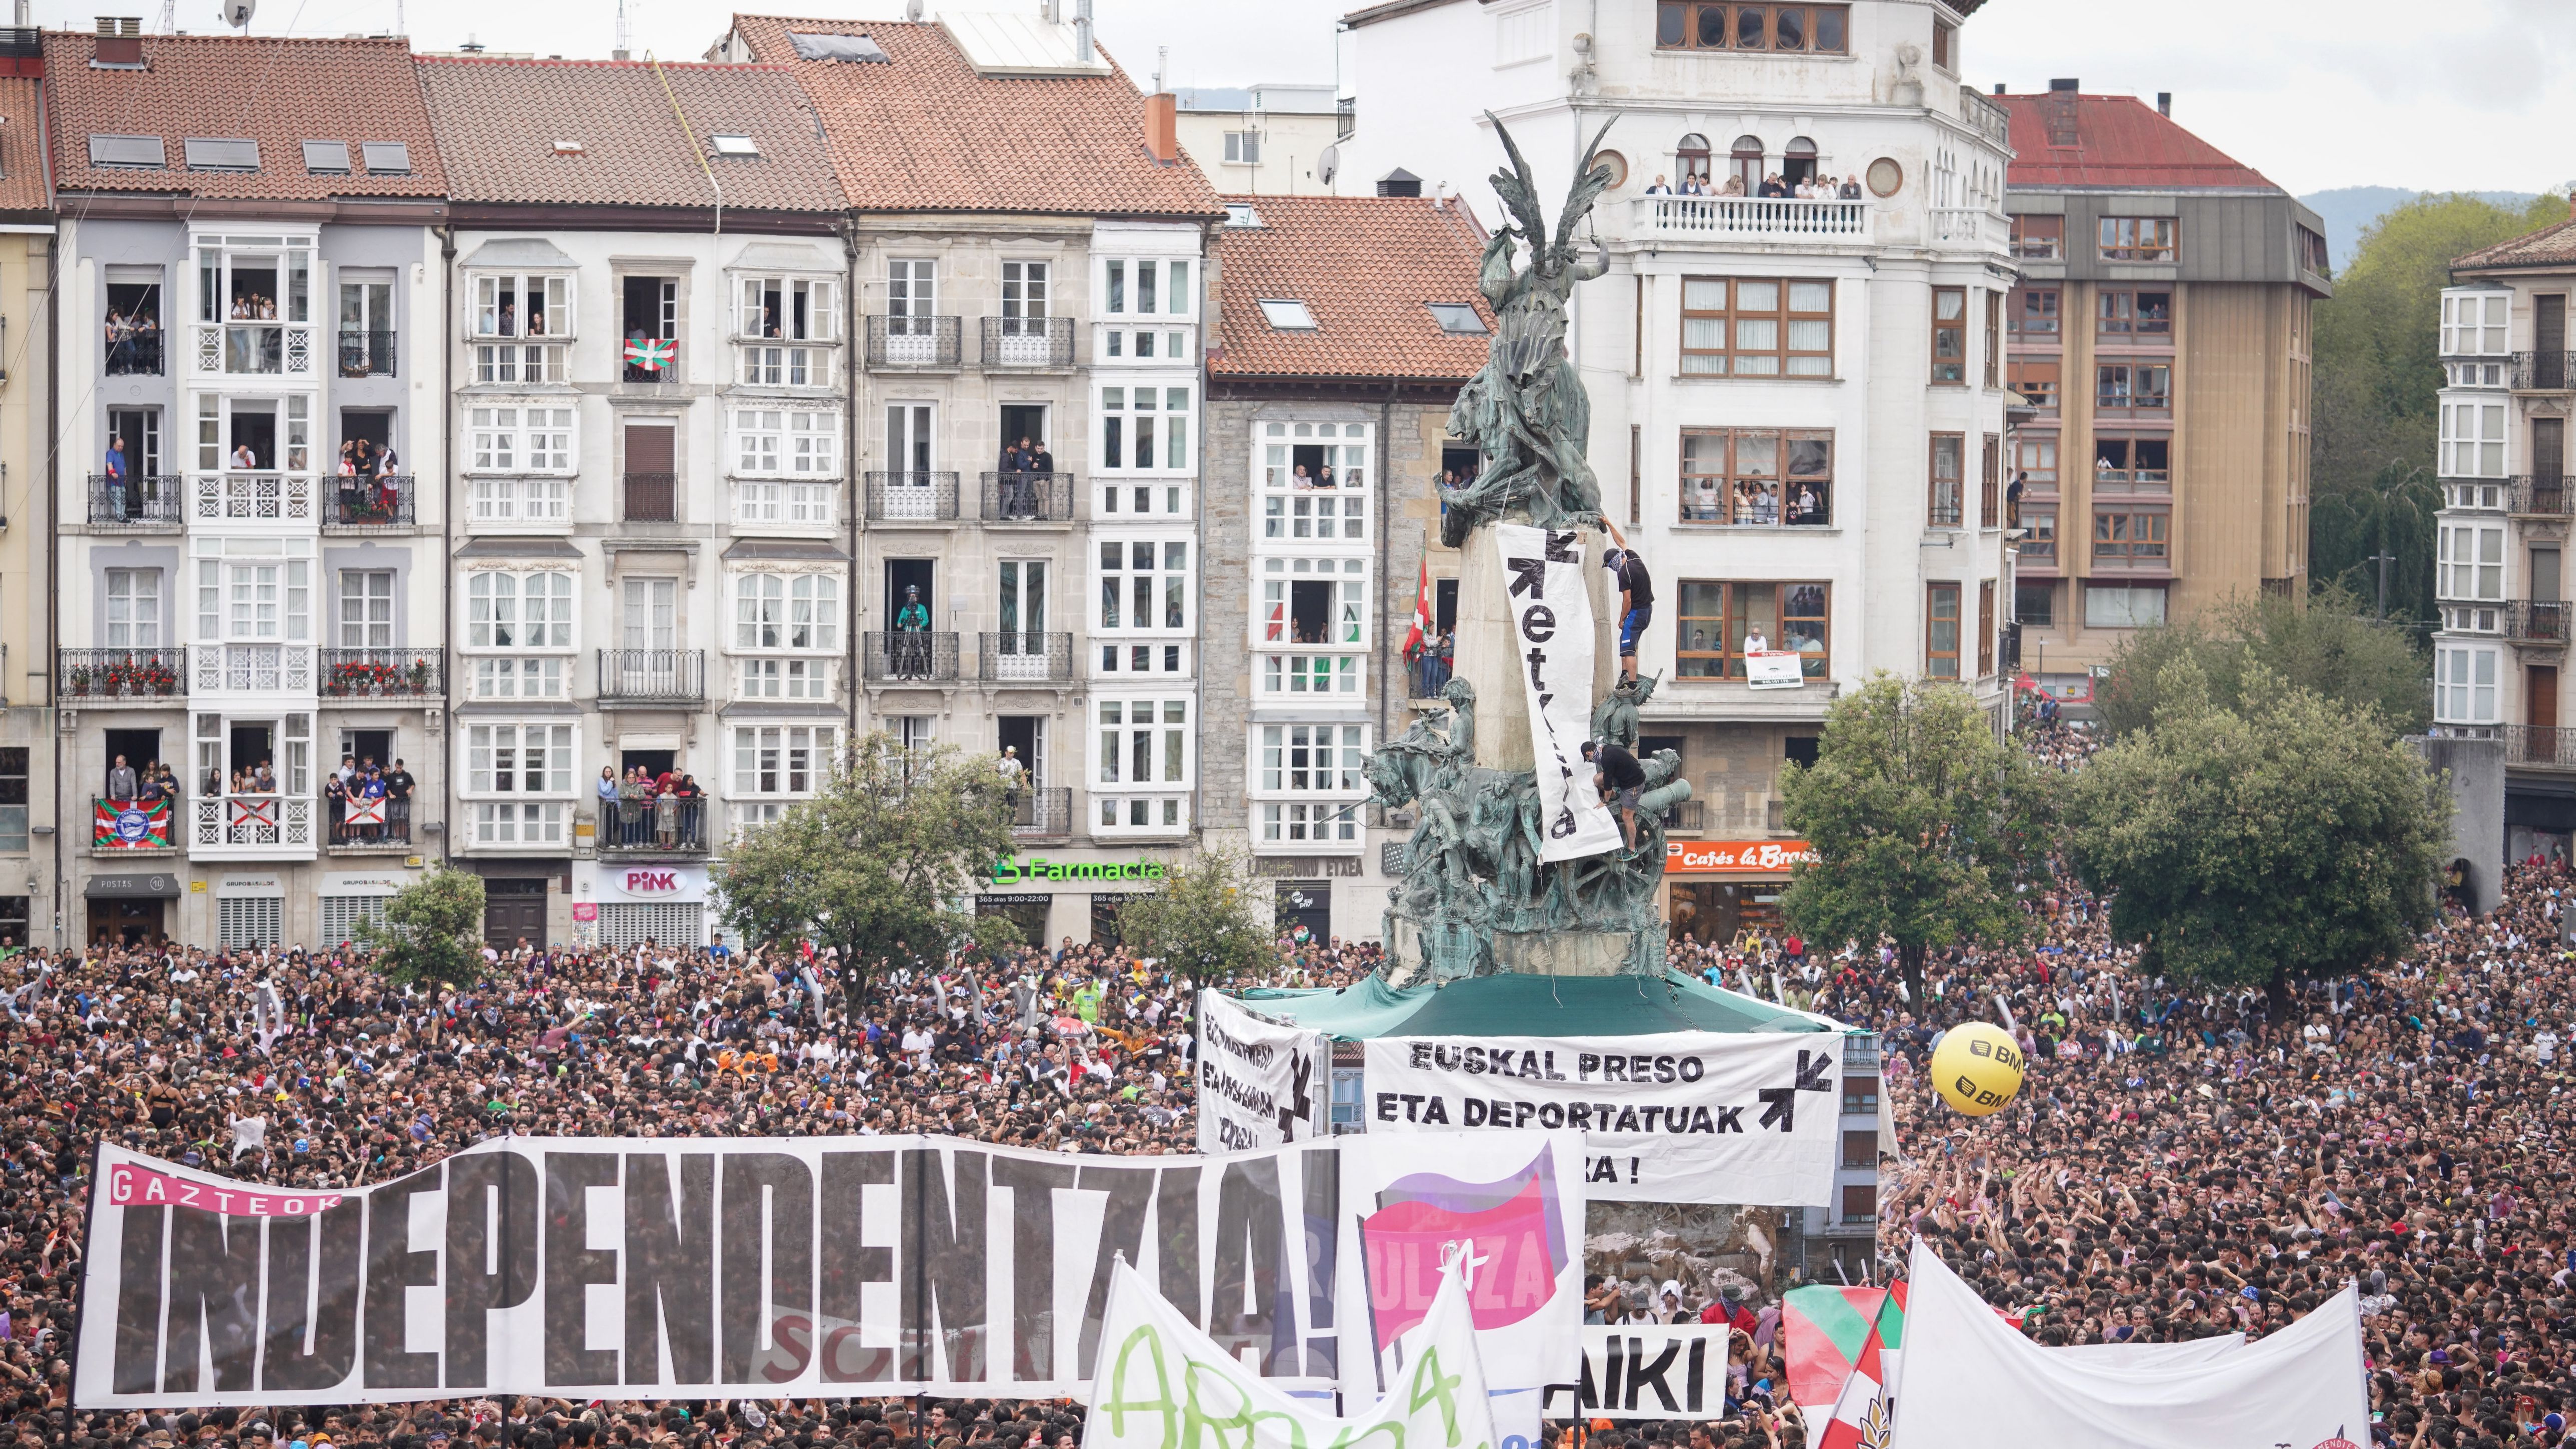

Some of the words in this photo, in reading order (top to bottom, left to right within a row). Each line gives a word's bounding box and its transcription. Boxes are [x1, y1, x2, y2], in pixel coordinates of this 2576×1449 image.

[1030, 856, 1164, 881] Farmacia
[1326, 857, 1364, 877] ETXEA
[1683, 851, 1735, 867] Cafés
[1739, 846, 1758, 866] la
[1409, 1041, 1567, 1082] EUSKAL
[1579, 1053, 1705, 1083] PRESO
[1995, 1045, 2022, 1074] BM
[1203, 1060, 1220, 1094] ETA
[1376, 1092, 1450, 1125] ETA
[1463, 1099, 1745, 1135] DEPORTATUAK
[1974, 1090, 2011, 1108] BM
[114, 1168, 341, 1216] GAZTEOK
